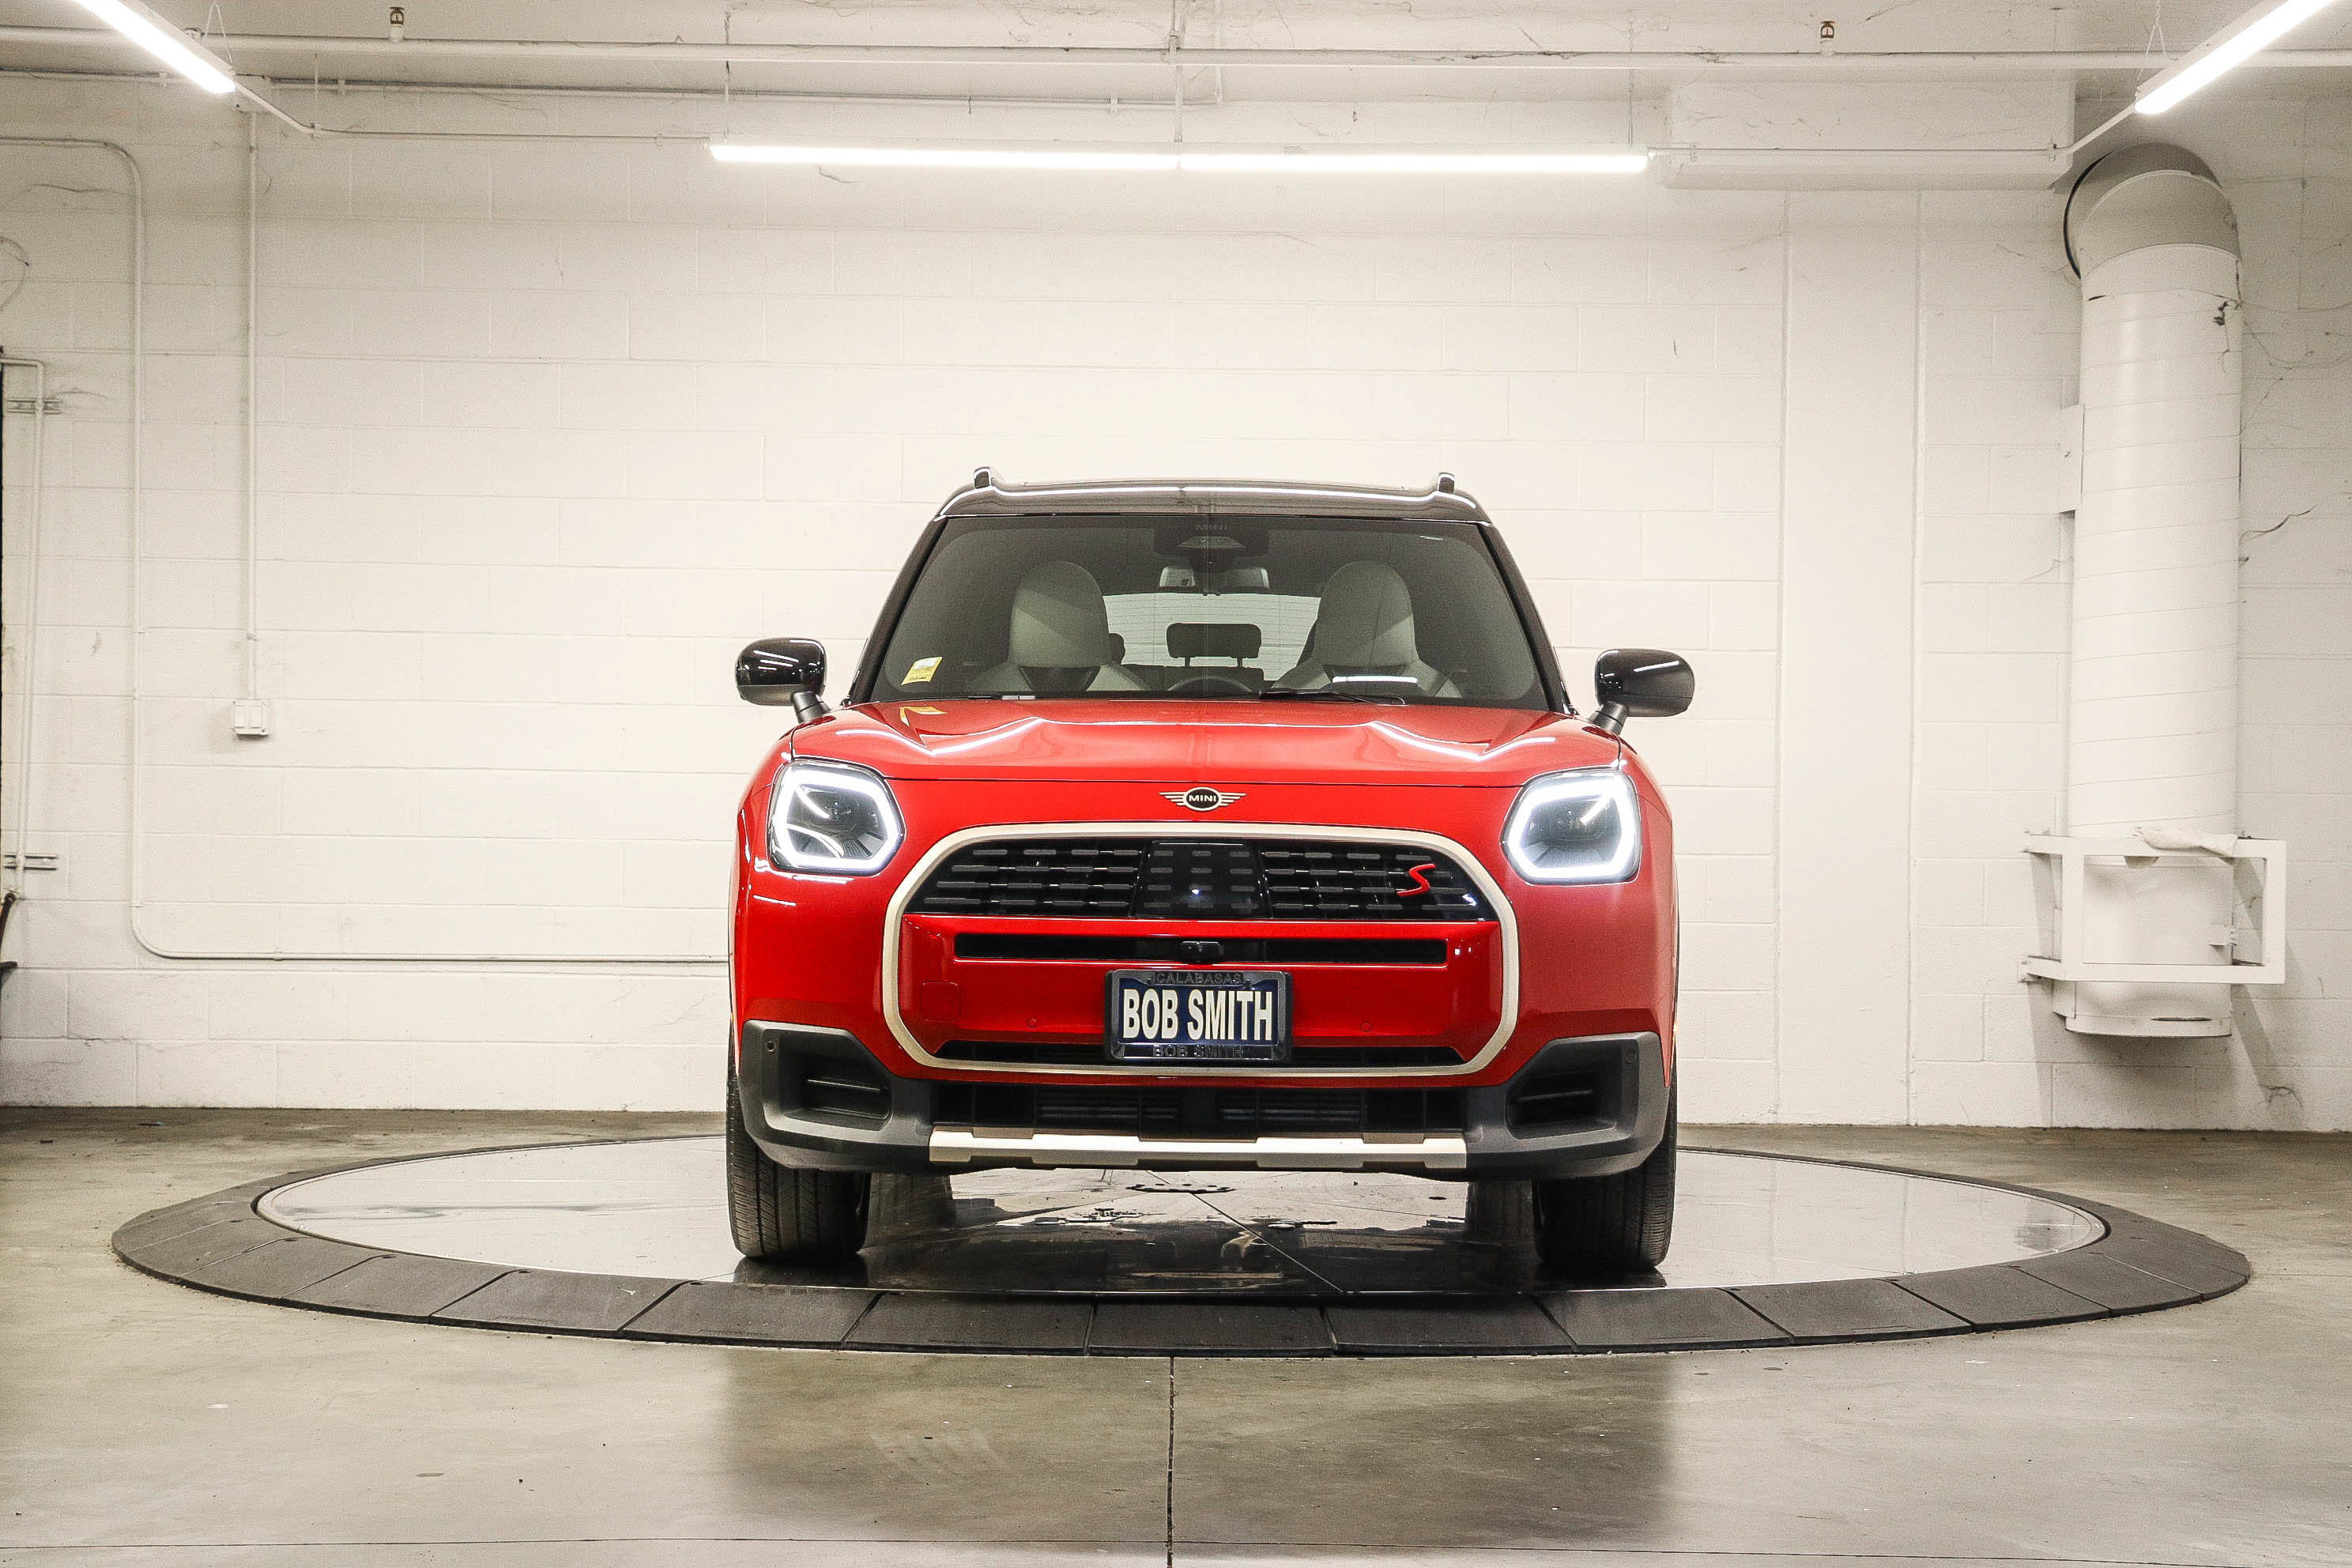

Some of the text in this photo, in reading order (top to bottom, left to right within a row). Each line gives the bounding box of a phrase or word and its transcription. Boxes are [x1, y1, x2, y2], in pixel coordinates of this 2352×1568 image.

[1396, 863, 1436, 897] S
[1156, 972, 1242, 985] CALABASAS
[1123, 988, 1272, 1042] BOB SMITH
[1152, 1044, 1243, 1059] BOB SMITH
